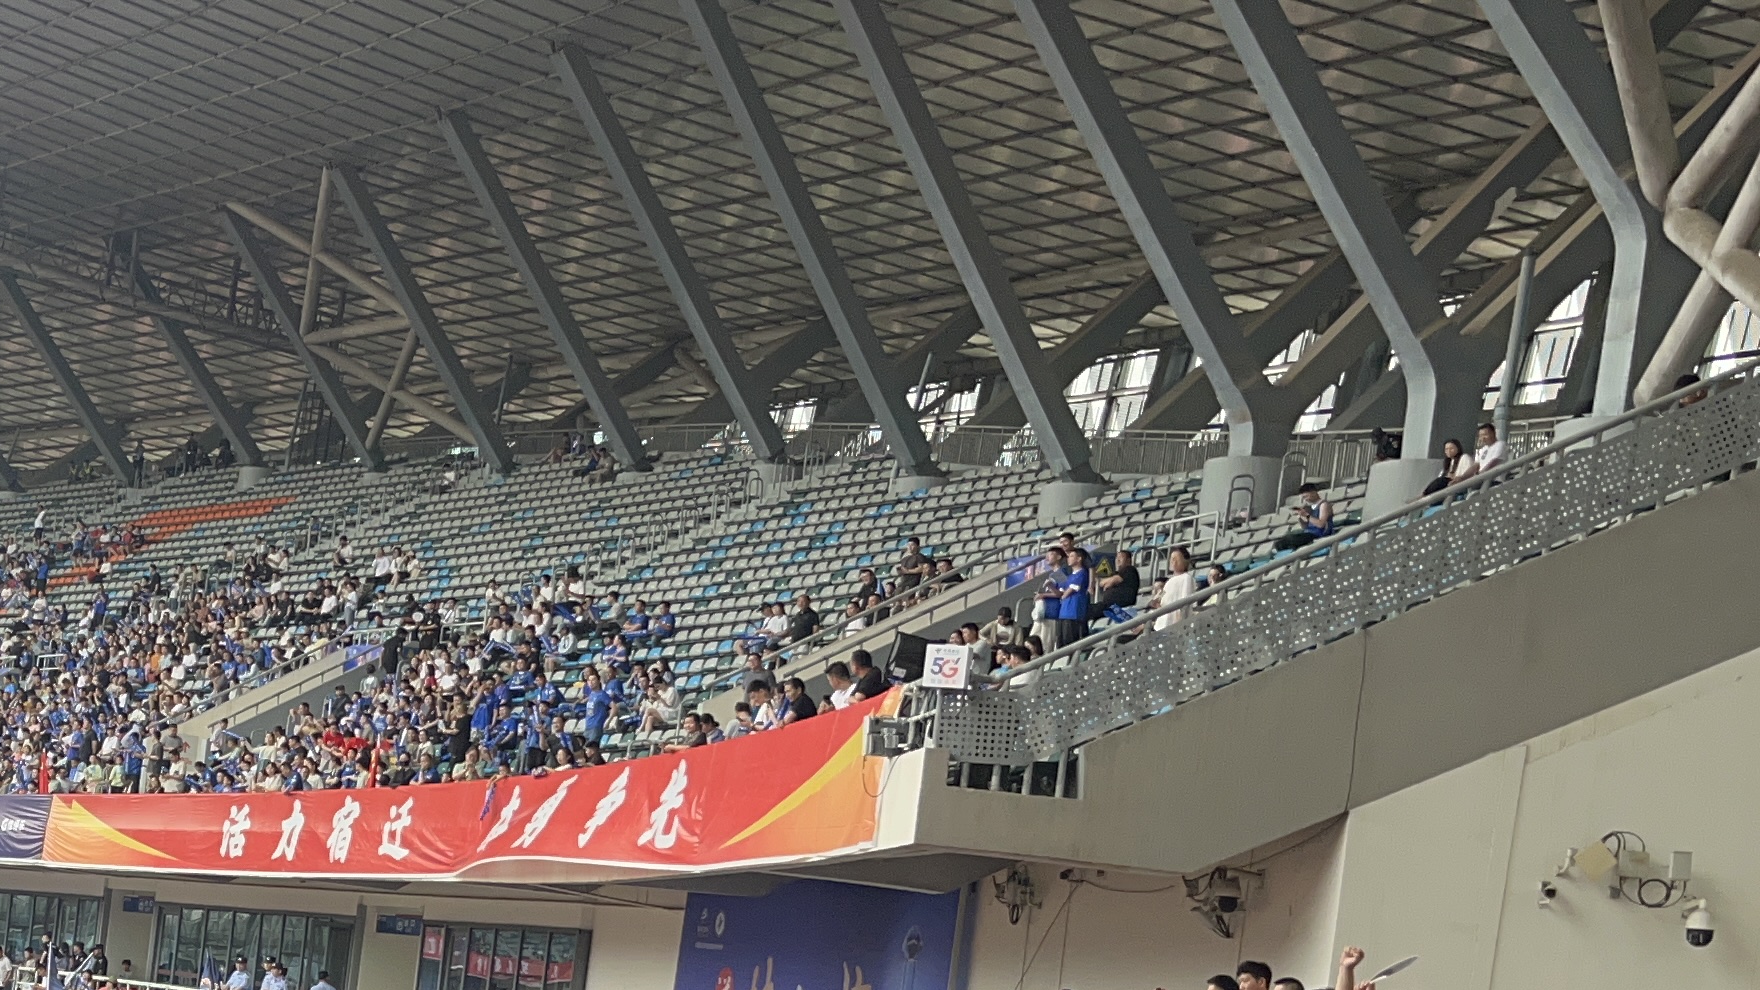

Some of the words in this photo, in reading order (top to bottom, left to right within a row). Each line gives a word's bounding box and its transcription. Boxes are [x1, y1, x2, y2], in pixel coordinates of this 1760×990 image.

[930, 657, 962, 679] 5G
[219, 795, 415, 864] 活力宿迁
